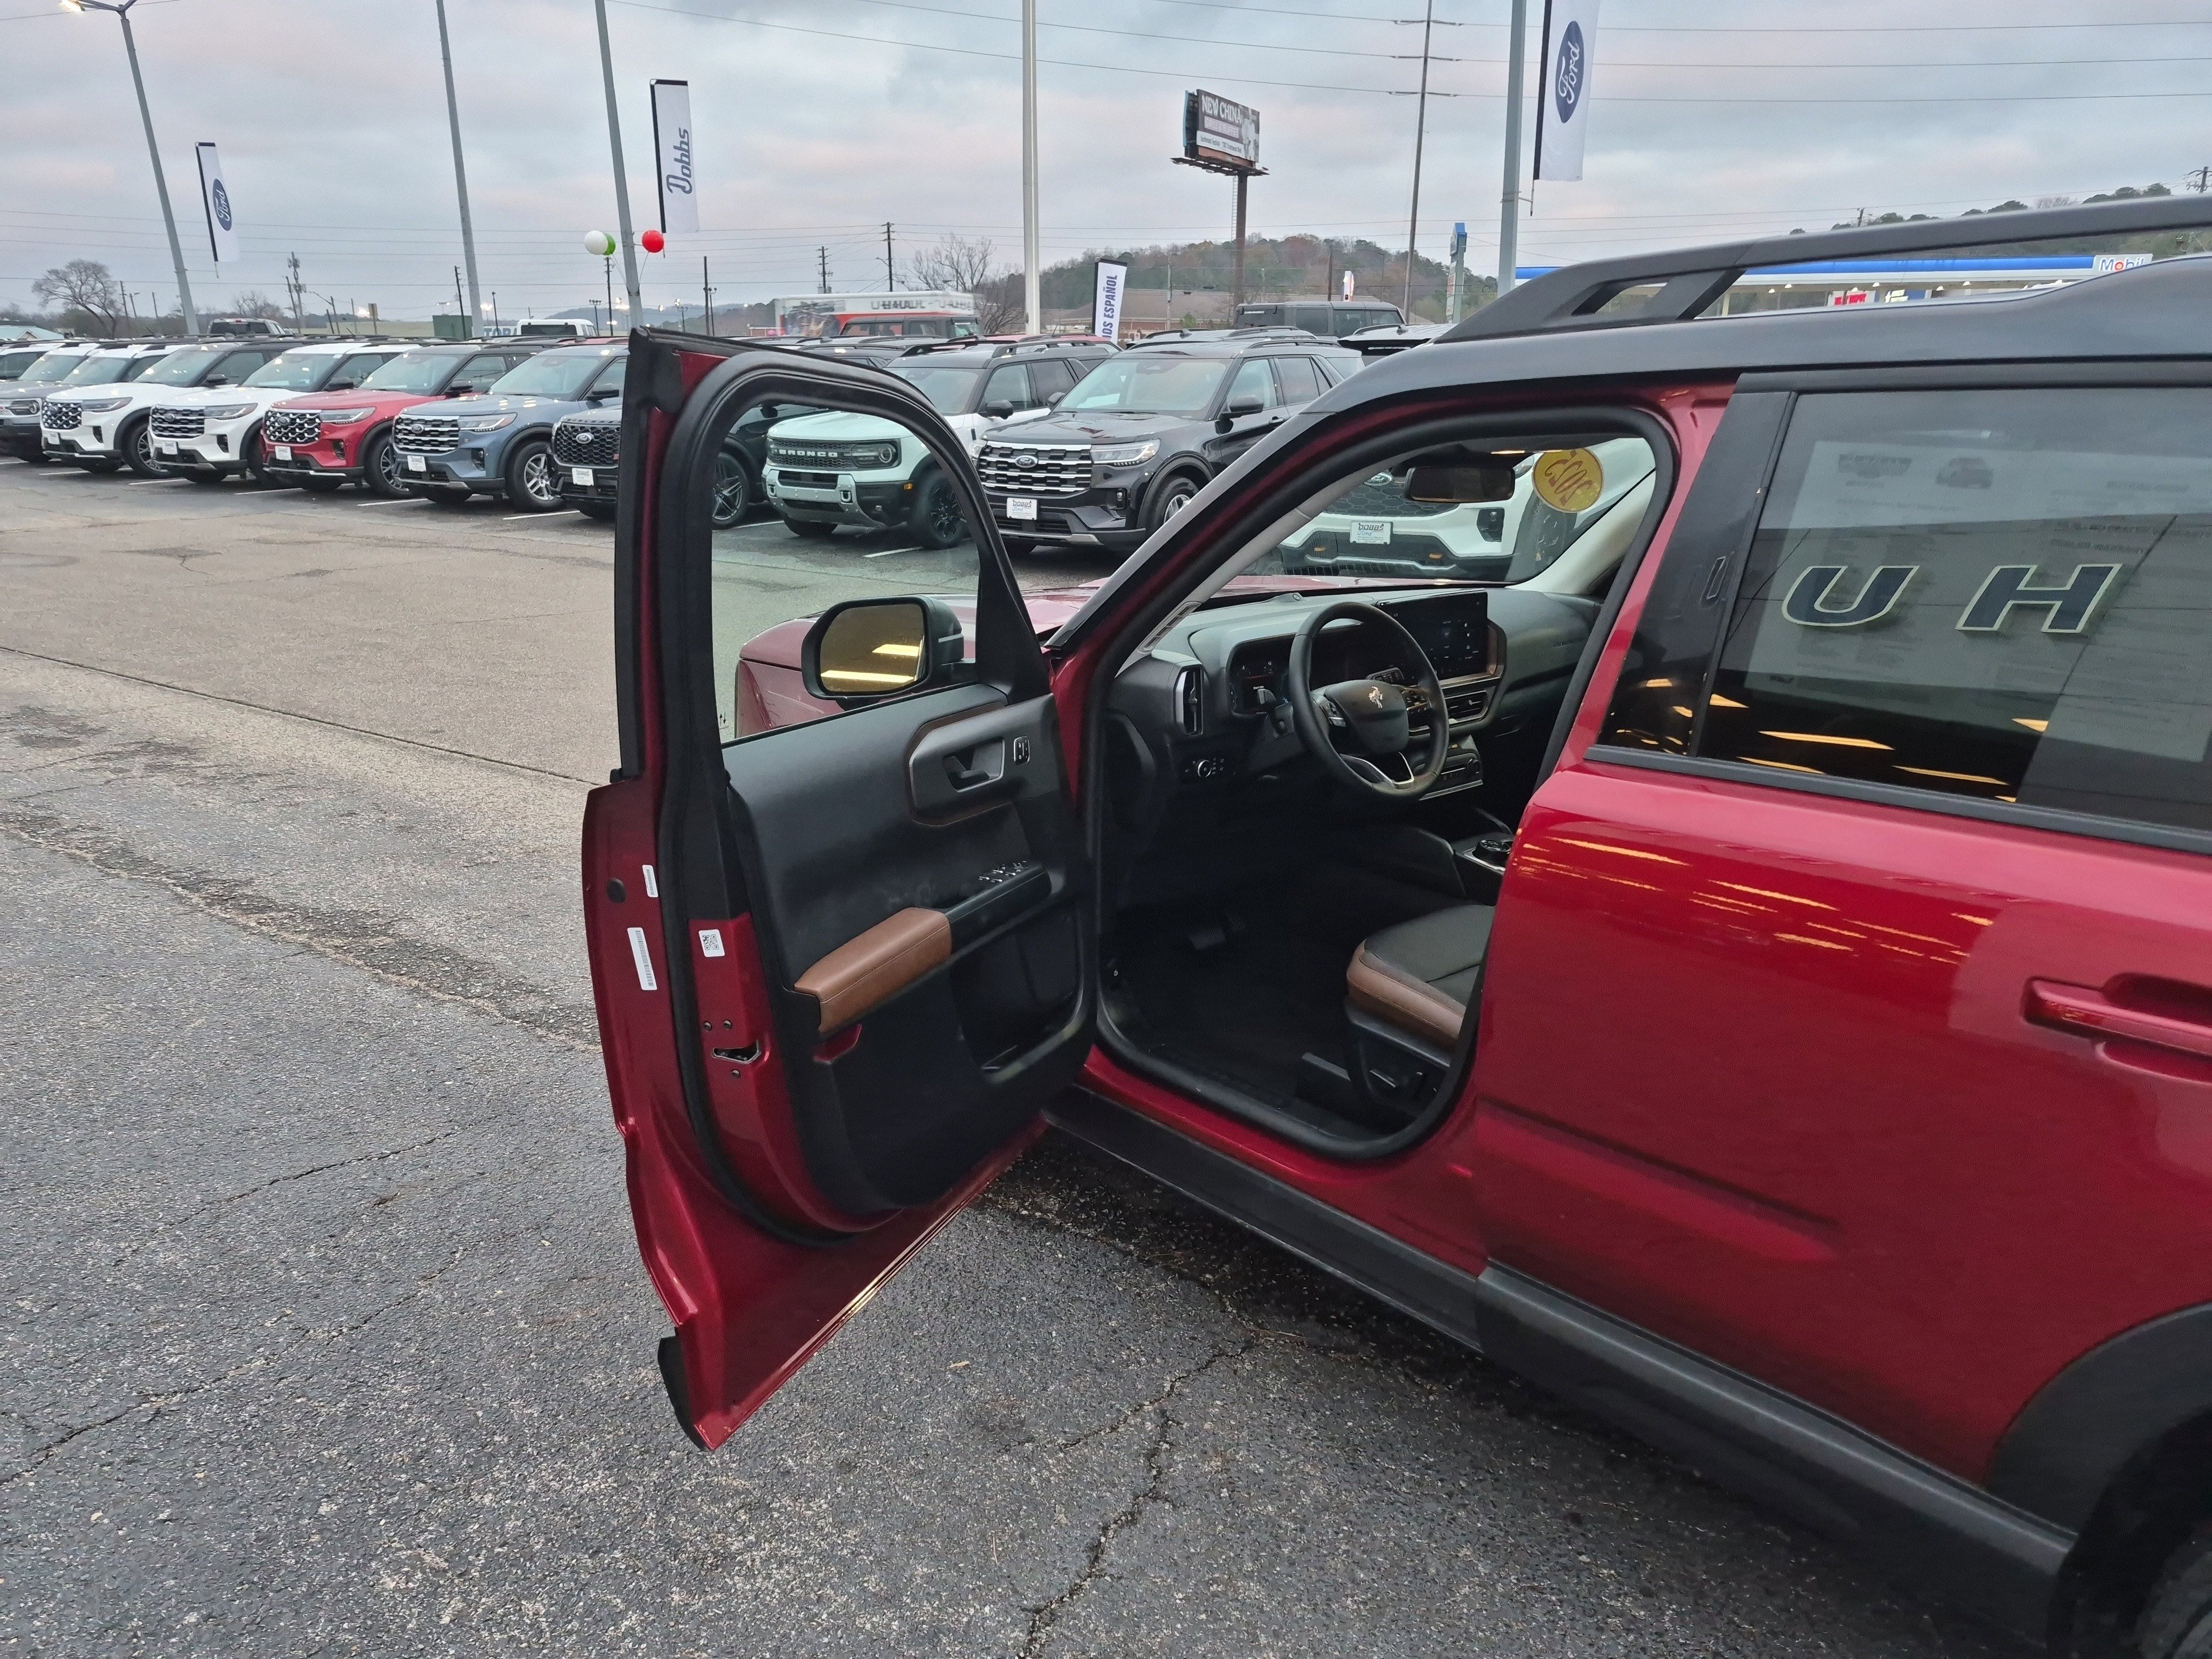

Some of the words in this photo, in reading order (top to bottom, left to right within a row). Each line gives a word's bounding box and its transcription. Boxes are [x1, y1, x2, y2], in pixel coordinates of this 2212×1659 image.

[1558, 41, 1580, 104] Ford
[1201, 94, 1219, 116] NEW
[1219, 101, 1242, 125] CHINA
[666, 127, 693, 195] Dobbs
[215, 189, 230, 222] Ford
[2100, 258, 2144, 271] Mobil
[1103, 275, 1118, 319] ESPAÑOL
[779, 449, 838, 458] BRONCO
